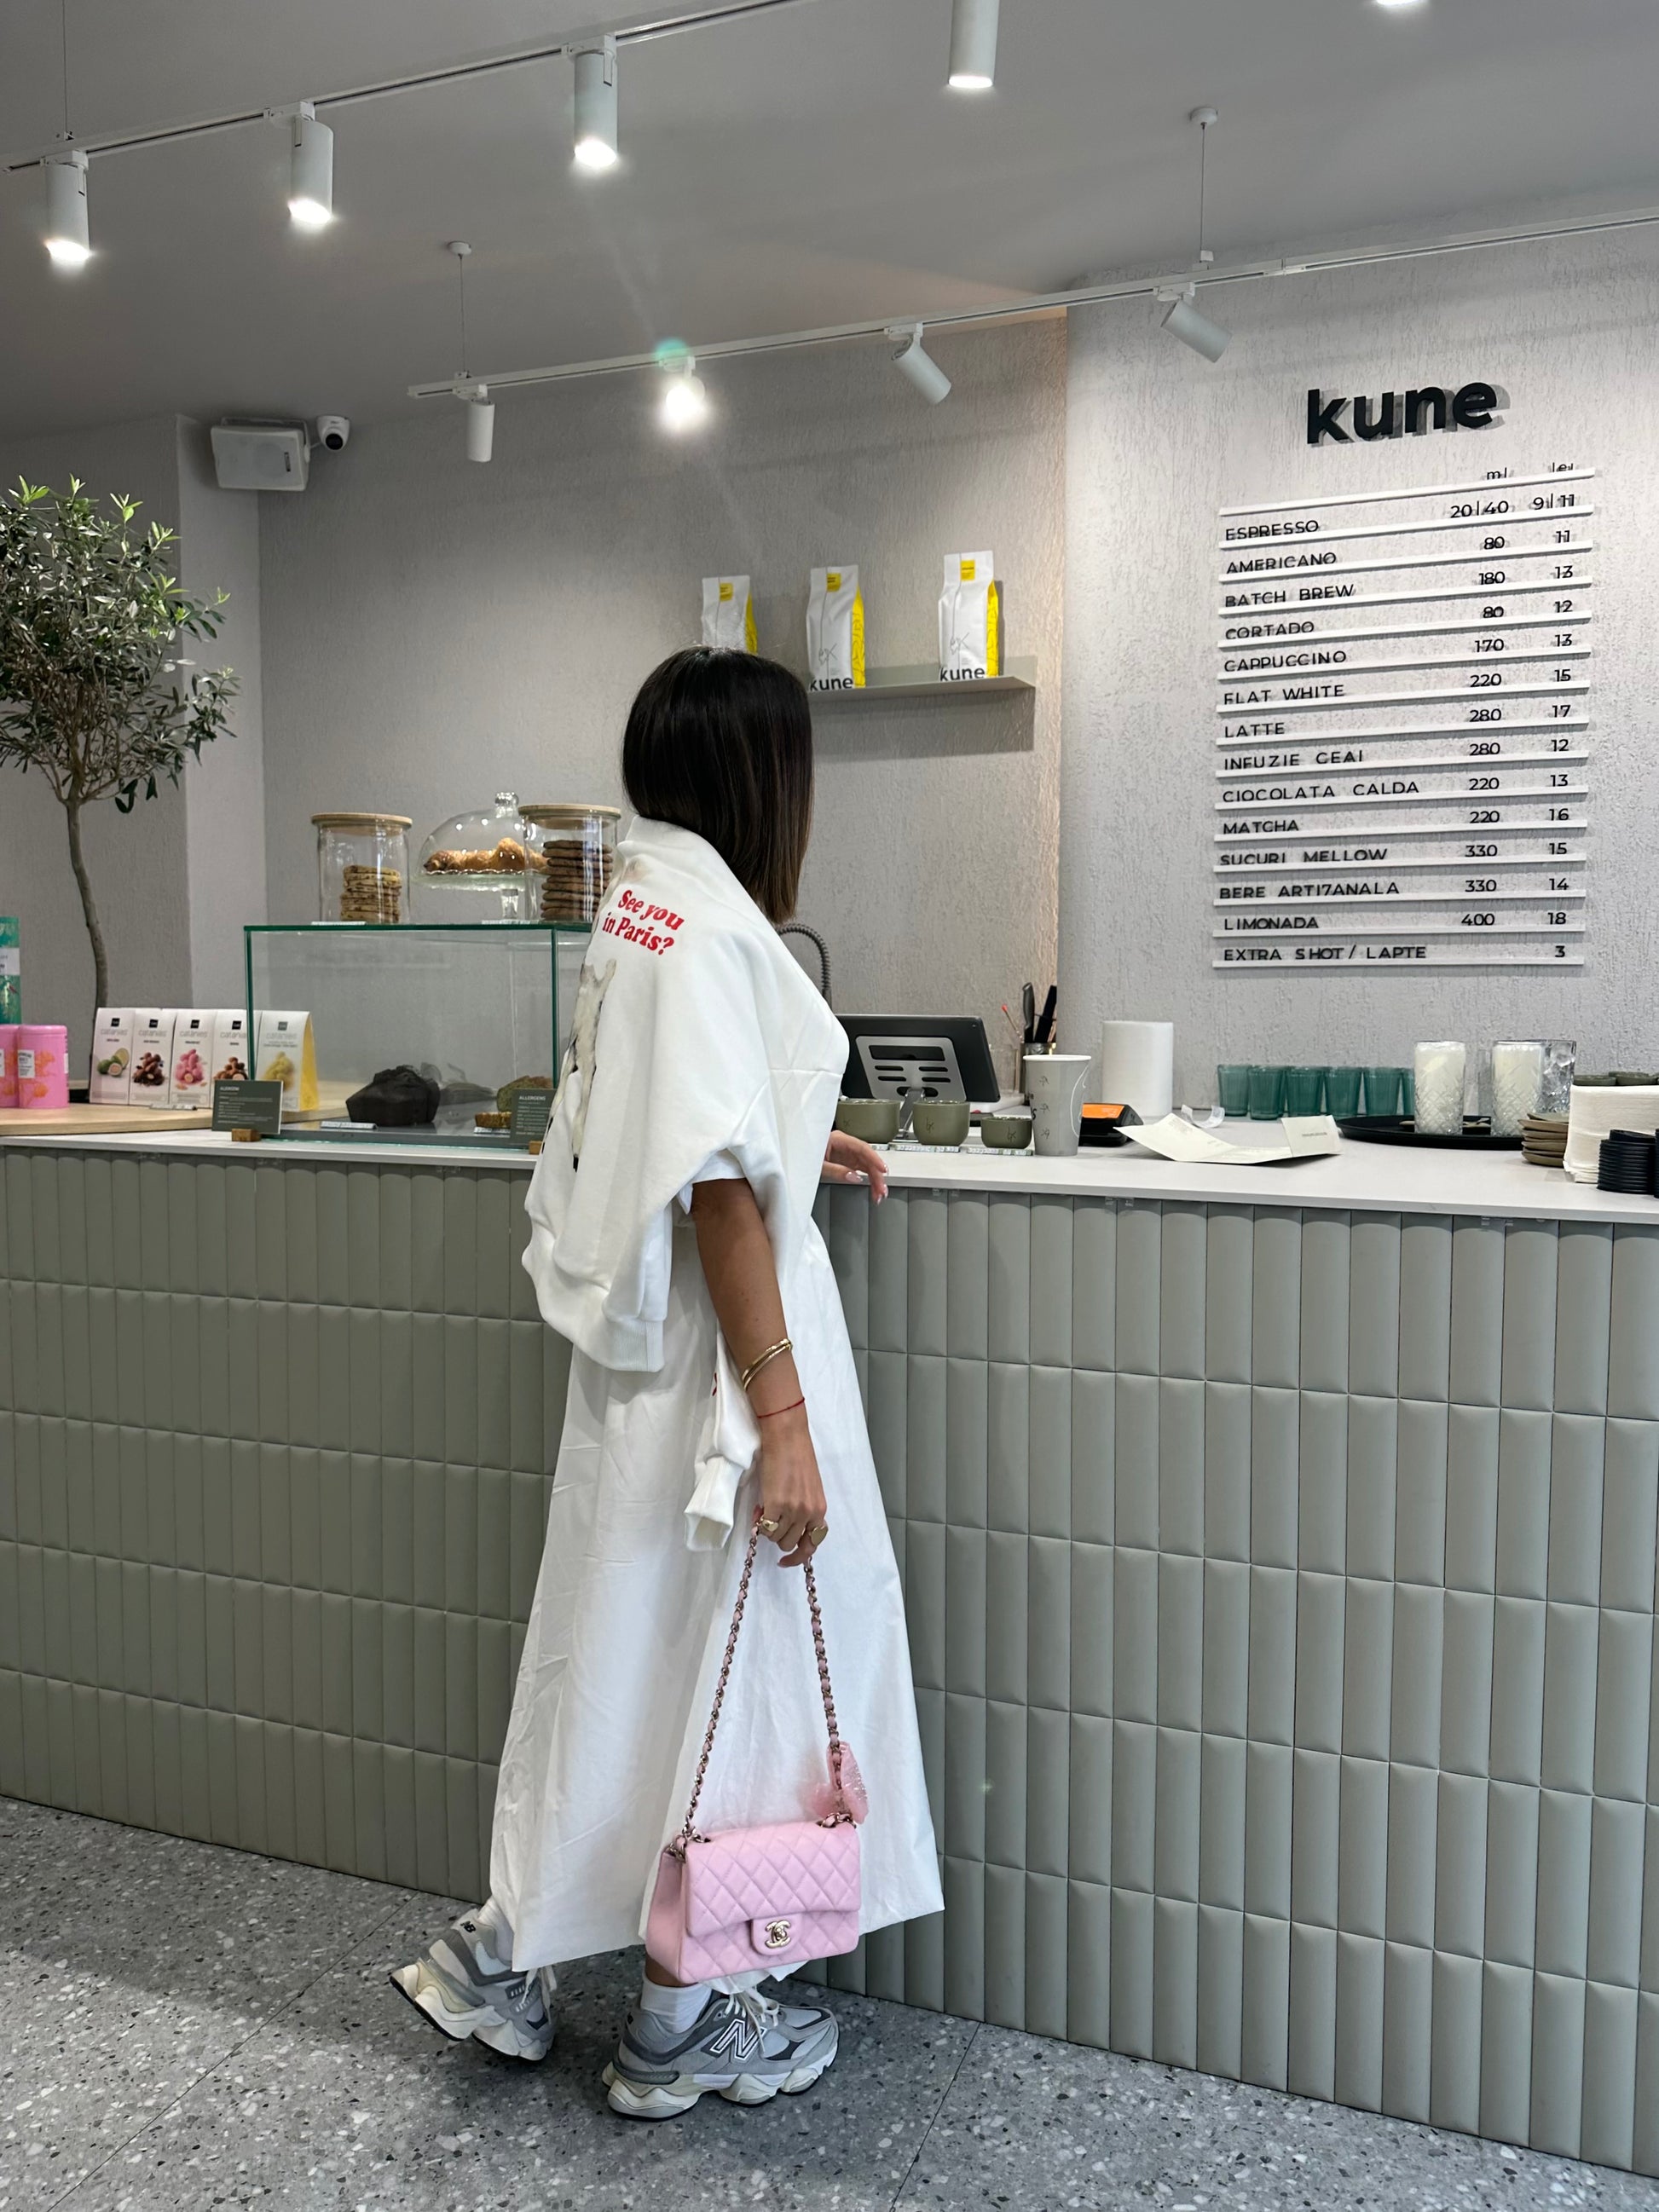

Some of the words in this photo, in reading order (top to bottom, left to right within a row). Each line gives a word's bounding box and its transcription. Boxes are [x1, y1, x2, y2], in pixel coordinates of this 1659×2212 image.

[1307, 382, 1498, 444] kune
[1225, 520, 1319, 540] ESPRESSO
[1227, 552, 1337, 574] AMERICANO
[1483, 536, 1505, 550] 80
[1556, 530, 1570, 543] 11
[1225, 591, 1286, 607] BATCH
[1299, 584, 1354, 600] BREW
[1478, 571, 1506, 585] 180
[1555, 565, 1573, 579] 13
[1225, 621, 1315, 639] CORTADO
[1483, 606, 1504, 618] 80
[1554, 600, 1573, 613] 12
[1224, 650, 1346, 672] CAPPUCCINO
[1475, 638, 1505, 652] 170
[1554, 633, 1573, 647] 13
[940, 667, 985, 682] kune
[1223, 690, 1271, 705] FLAT
[1282, 684, 1344, 700] WHITE
[1470, 673, 1502, 688] 220
[1554, 668, 1571, 682] 15
[1224, 722, 1285, 738] LATTE
[1469, 708, 1502, 722] 280
[1552, 705, 1571, 718] 17
[1224, 754, 1300, 770] INFUZIE
[1315, 750, 1362, 764] CEAI
[1469, 742, 1500, 756] 280
[1551, 739, 1569, 752] 12
[1223, 786, 1336, 803] CIOCOLATA
[1352, 781, 1419, 796] CALDA
[1468, 777, 1500, 790] 220
[1550, 774, 1569, 787] 13
[1223, 820, 1299, 835] MATCHA
[1469, 811, 1500, 823] 220
[1548, 808, 1569, 821] 16
[1220, 852, 1286, 866] SUCURI
[1304, 848, 1388, 863] MELLOW
[1465, 845, 1498, 858] 330
[1549, 842, 1568, 855] 15
[1220, 887, 1266, 899] BERE
[1465, 880, 1497, 892] 330
[1549, 878, 1569, 891] 14
[618, 889, 645, 914] See
[639, 904, 685, 930] you
[1224, 917, 1319, 930] LIMONADA
[1461, 913, 1495, 927] 400
[1547, 912, 1567, 925] 18
[602, 912, 616, 933] in
[615, 917, 674, 956] Paris?
[1224, 949, 1282, 961] EXTRA
[1295, 947, 1344, 960] SHOT
[1367, 946, 1426, 959] LAPTE
[1555, 945, 1565, 958] 3
